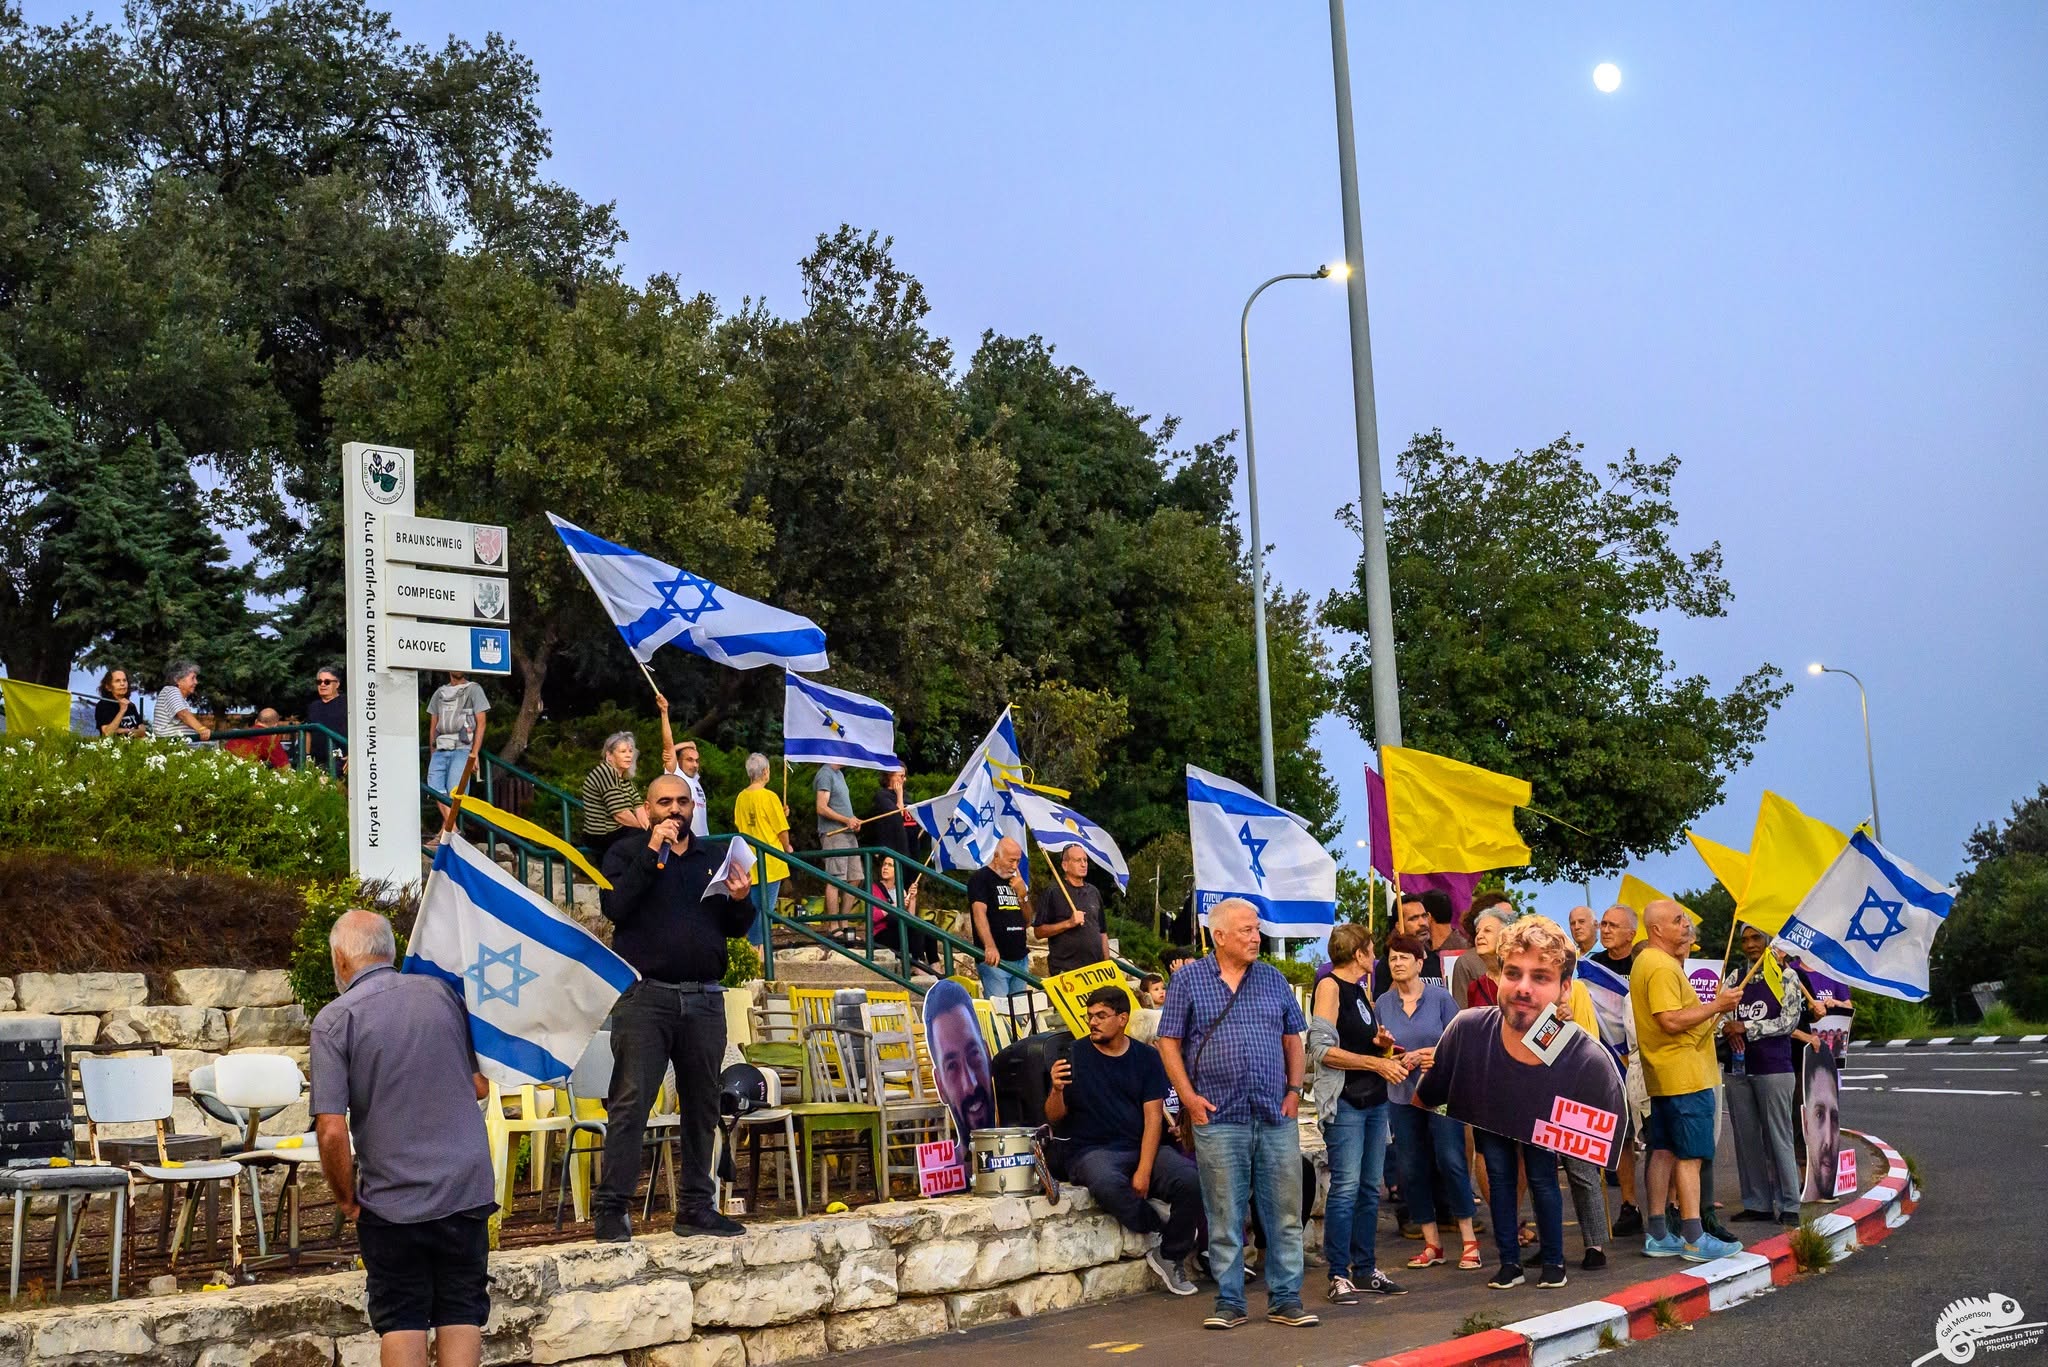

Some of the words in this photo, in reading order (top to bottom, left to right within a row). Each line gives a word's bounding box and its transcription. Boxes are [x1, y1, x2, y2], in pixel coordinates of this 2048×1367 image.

[364, 511, 376, 544] קרית
[396, 532, 462, 550] BRAUNSCHWEIG
[365, 548, 378, 619] טבעון-ערים
[397, 585, 456, 601] COMPIEGNE
[366, 624, 376, 673] תאומות
[365, 681, 377, 721] Cities
[366, 725, 378, 802] Tivon-Twin
[368, 805, 381, 848] Kiryat
[1074, 966, 1116, 985] שחרור
[1689, 977, 1708, 986] שלום
[1555, 1100, 1615, 1134] עדיין
[919, 1141, 953, 1168] עדיין
[1535, 1125, 1608, 1163] בעזה.
[990, 1157, 1016, 1168] בארצנו
